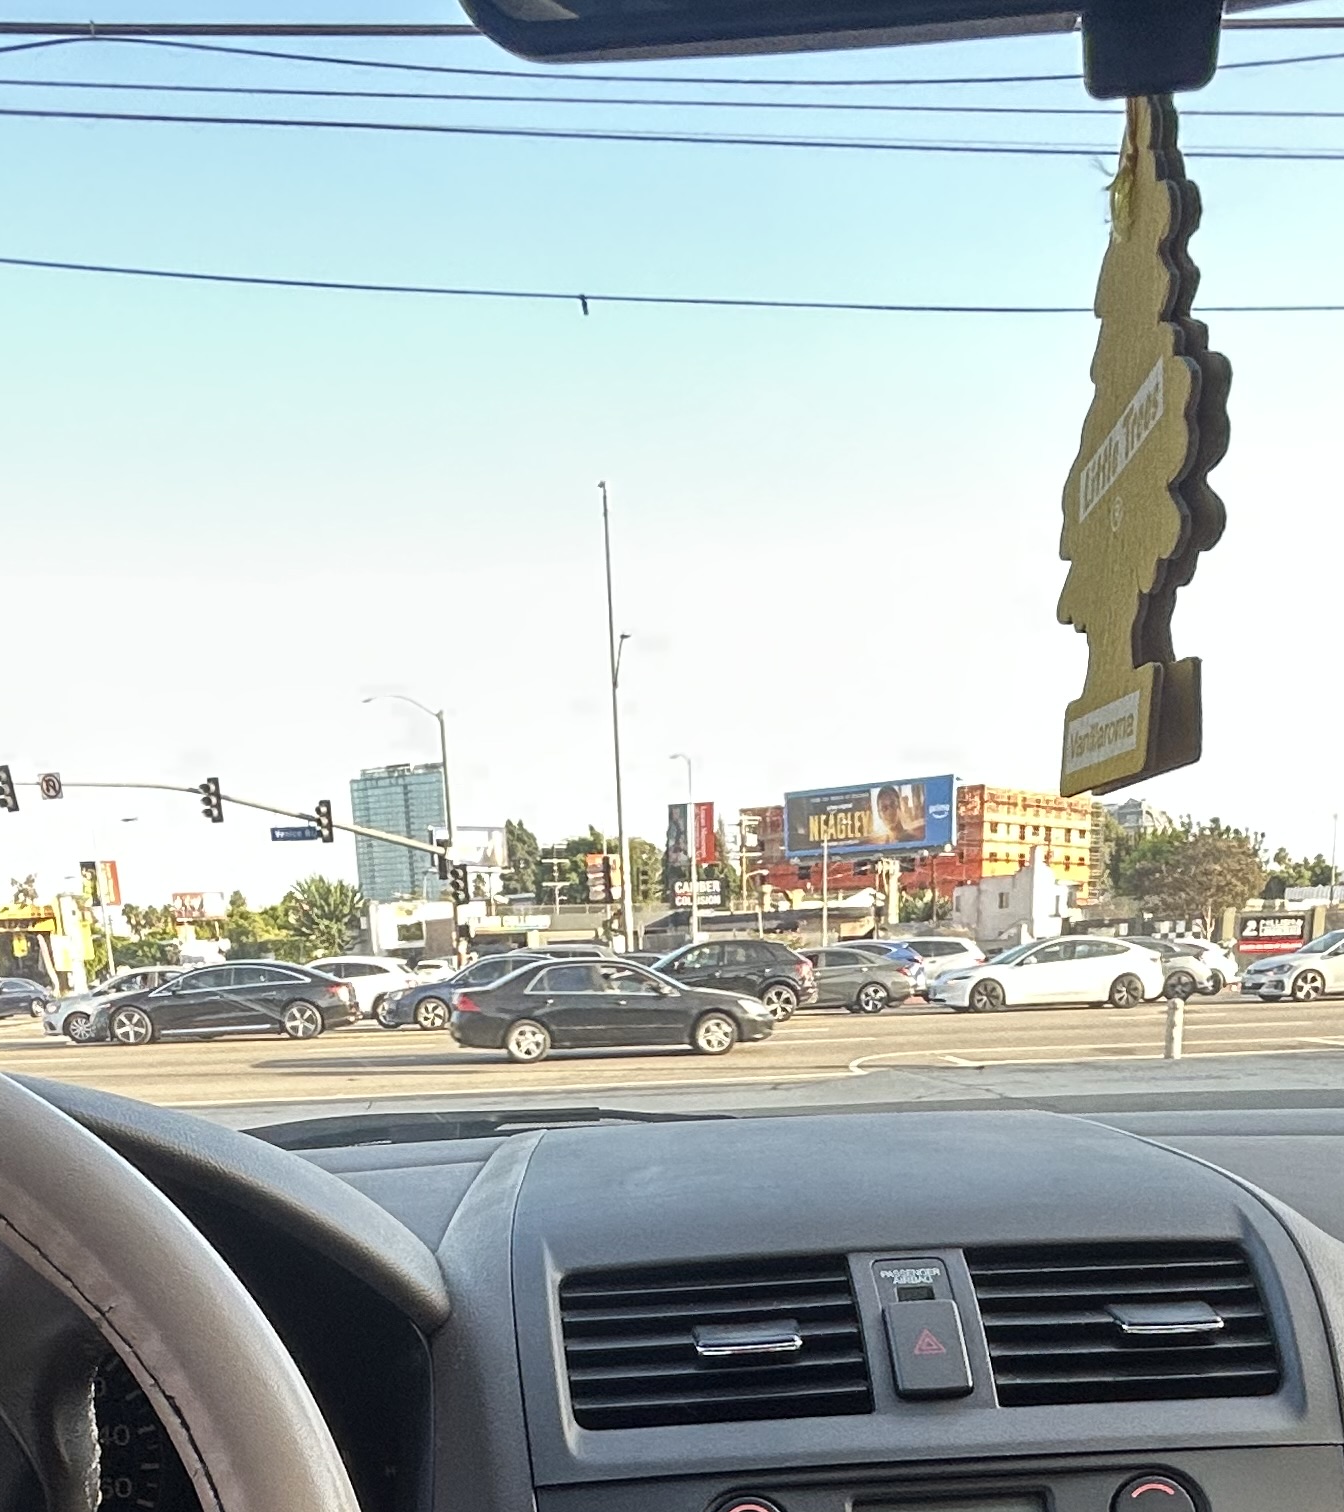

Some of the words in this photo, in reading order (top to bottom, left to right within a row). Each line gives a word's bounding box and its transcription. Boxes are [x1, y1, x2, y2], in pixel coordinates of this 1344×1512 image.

[1085, 434, 1120, 513] Little
[809, 810, 873, 842] NEAGLEY
[674, 894, 721, 907] COLISION
